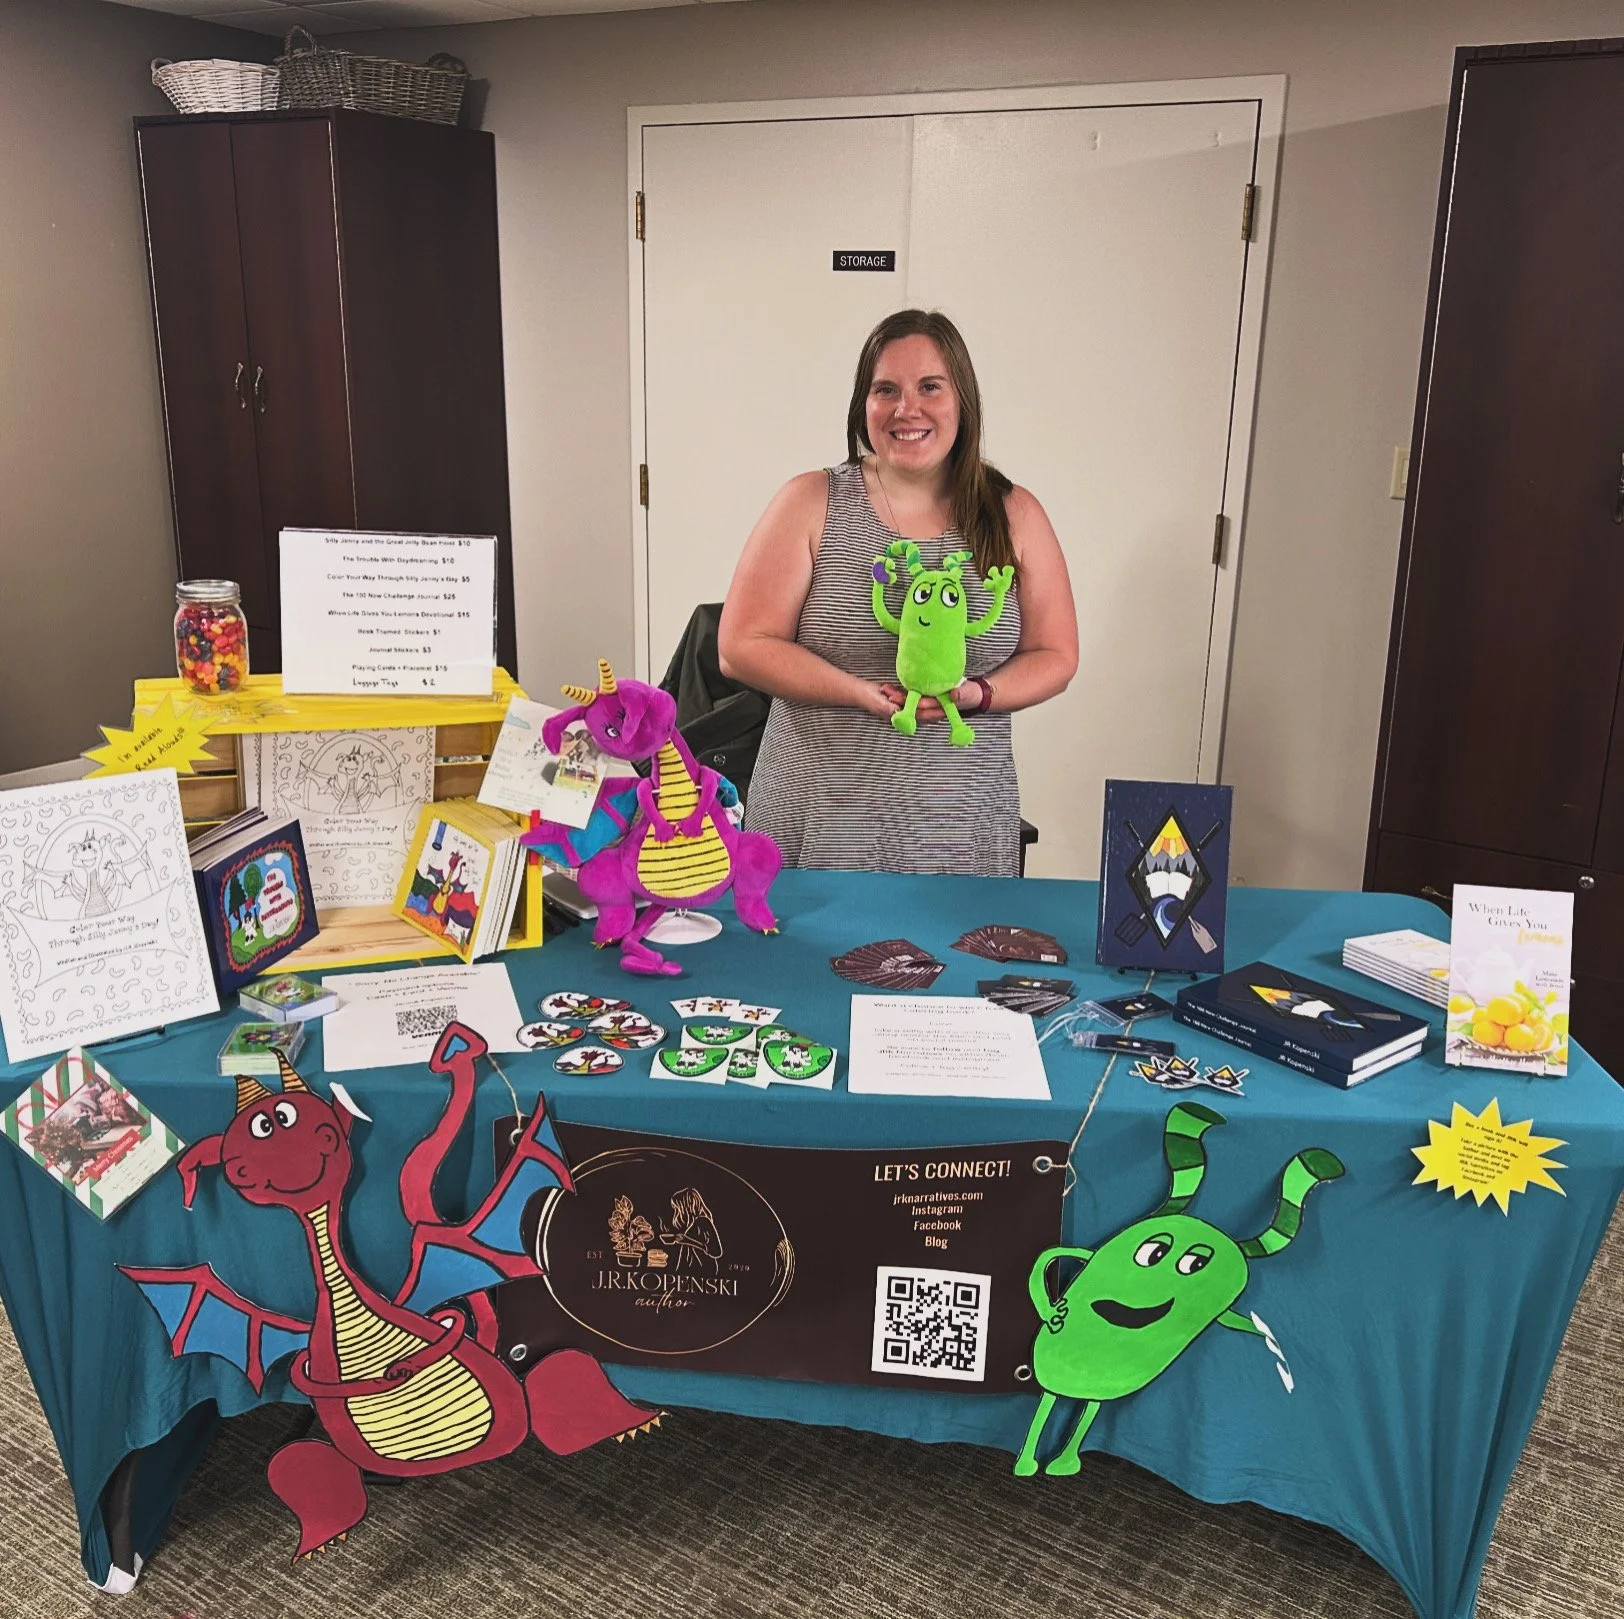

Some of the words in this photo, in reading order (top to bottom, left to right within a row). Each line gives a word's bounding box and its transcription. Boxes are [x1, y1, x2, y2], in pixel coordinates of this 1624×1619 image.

[840, 256, 887, 266] STORAGE
[422, 646, 431, 654] $3
[134, 728, 163, 752] available
[135, 754, 156, 771] Read
[1469, 902, 1503, 914] When
[1508, 906, 1530, 916] Life
[70, 923, 94, 934] Color
[118, 915, 135, 923] Way
[1488, 917, 1520, 927] Gives
[1526, 919, 1547, 930] You
[49, 935, 85, 948] Through
[1187, 1002, 1195, 1010] The
[1216, 1013, 1238, 1027] Challenge
[1239, 1024, 1257, 1034] Journal
[412, 1030, 442, 1039] venm
[1211, 1027, 1234, 1040] Challenge
[1234, 1036, 1252, 1048] Journal
[1292, 1042, 1320, 1059] Kopenski
[1287, 1056, 1315, 1074] Kopenski
[1478, 1143, 1496, 1151] picture
[93, 1158, 109, 1172] Merry
[108, 1137, 133, 1159] Christmas
[874, 1164, 919, 1182] LET'S
[925, 1160, 1011, 1179] CONNECT!
[1462, 1167, 1484, 1176] Facebook
[893, 1192, 984, 1205] jrknarratives.com
[911, 1205, 963, 1216] Instagram
[914, 1220, 961, 1231] Facebook
[925, 1236, 948, 1249] Blog
[586, 1250, 603, 1259] EST
[591, 1270, 738, 1296] J.R.KOPENSKI
[635, 1287, 695, 1314] author
